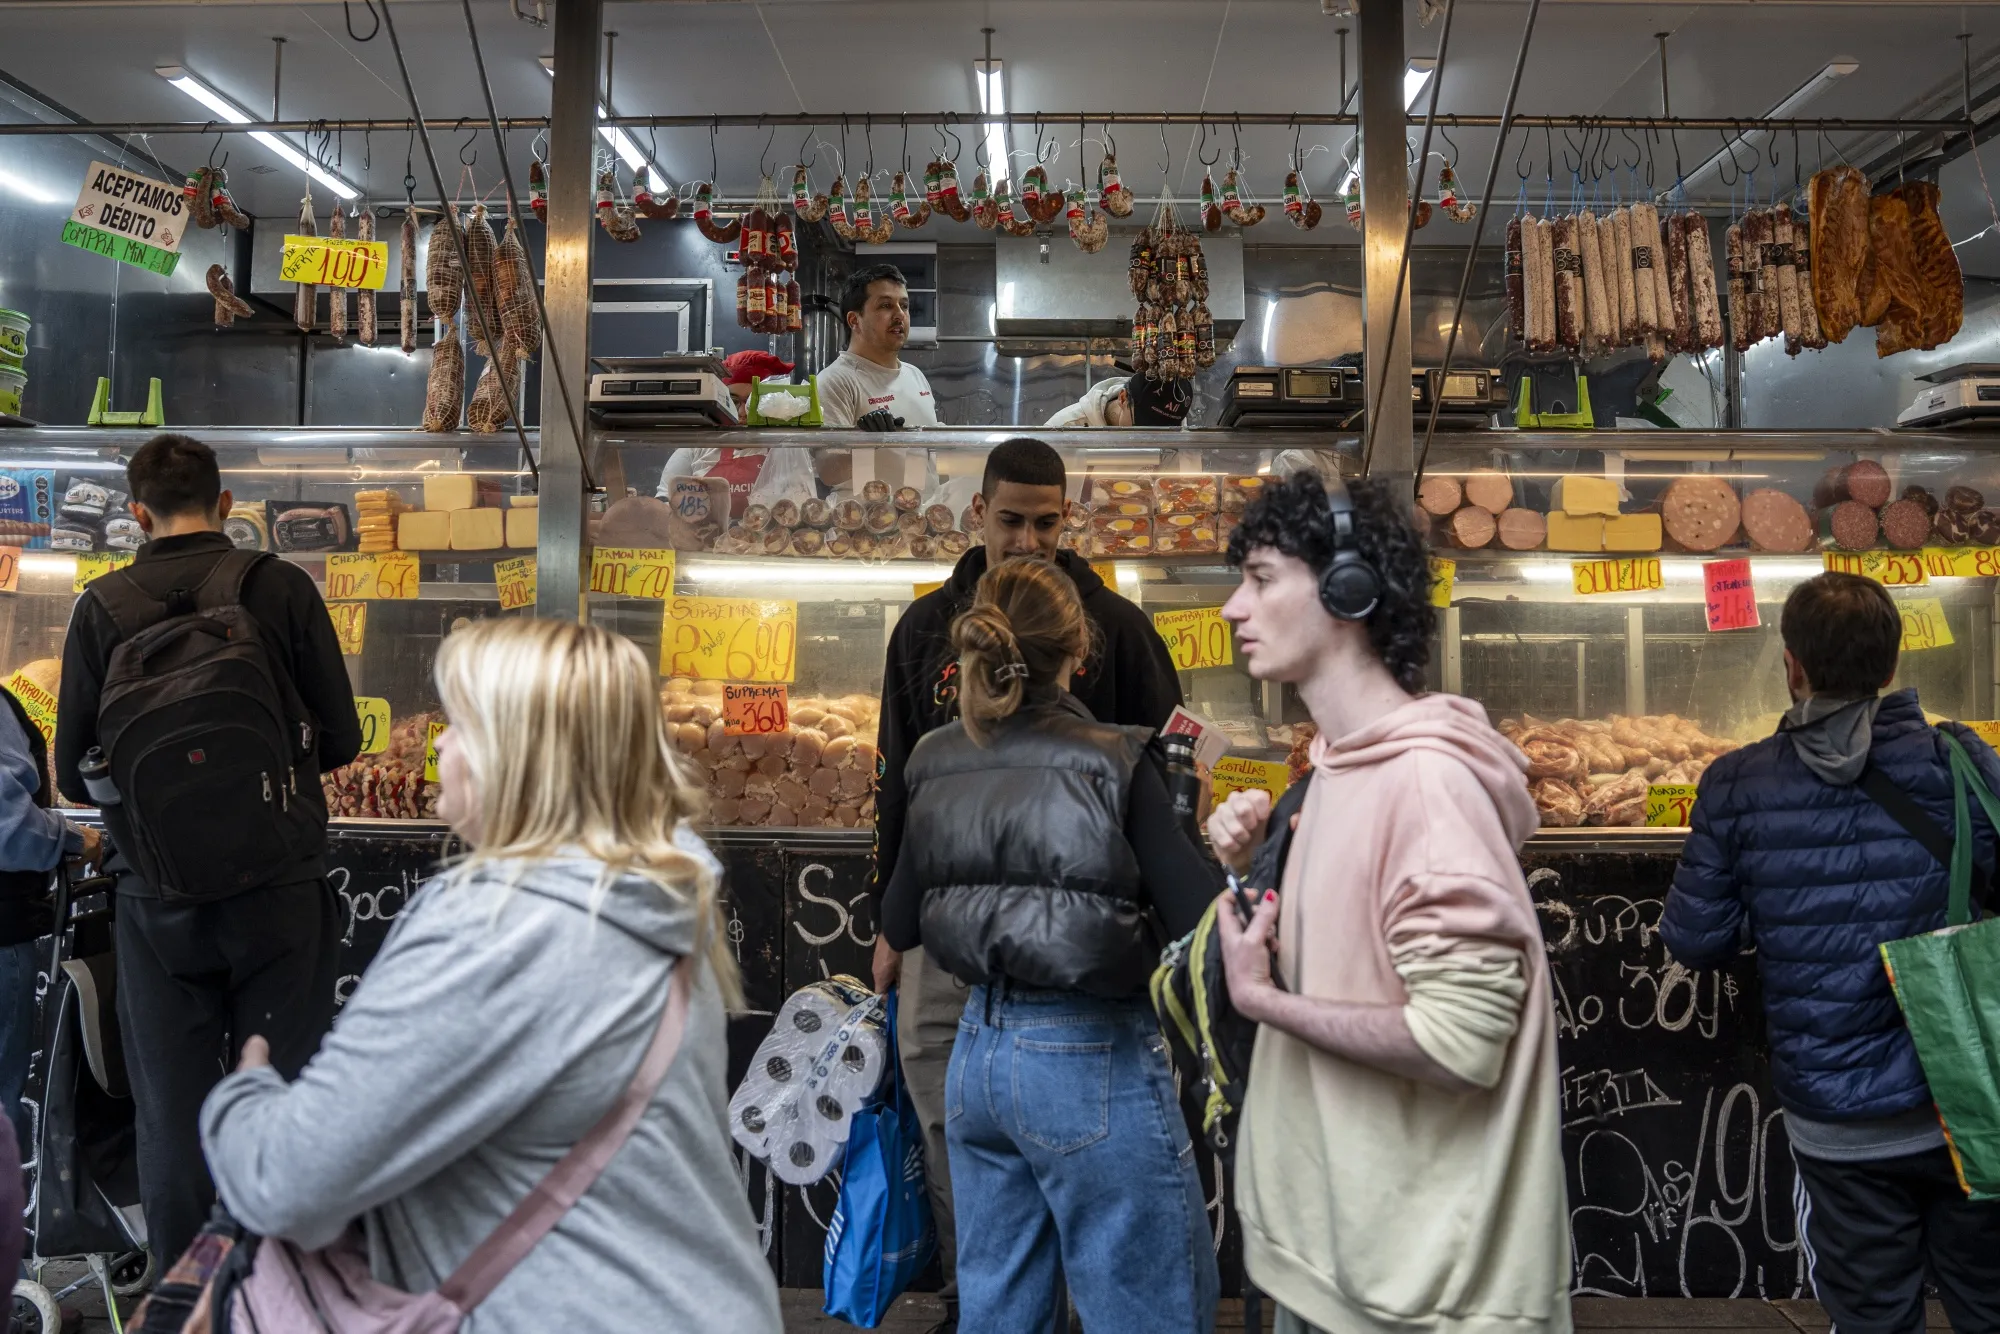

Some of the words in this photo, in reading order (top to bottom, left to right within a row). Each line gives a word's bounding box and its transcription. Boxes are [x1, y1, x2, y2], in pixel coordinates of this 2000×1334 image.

[92, 169, 184, 216] ACEPTAMOS
[99, 201, 156, 240] DÉBITO
[61, 222, 115, 256] COMPRA
[728, 481, 754, 493] HACI
[595, 549, 634, 560] JAMON
[1883, 554, 1922, 585] 53
[327, 572, 354, 598] 100
[376, 563, 413, 599] 67
[591, 563, 627, 594] 100
[1574, 559, 1620, 595] 300
[499, 581, 528, 608] 300
[670, 624, 700, 678] 2
[726, 618, 795, 681] 699
[11, 674, 58, 713] ARROLLAD
[725, 685, 784, 700] SUPREMA
[741, 700, 787, 733] 369
[1560, 1066, 1672, 1116] FERTA
